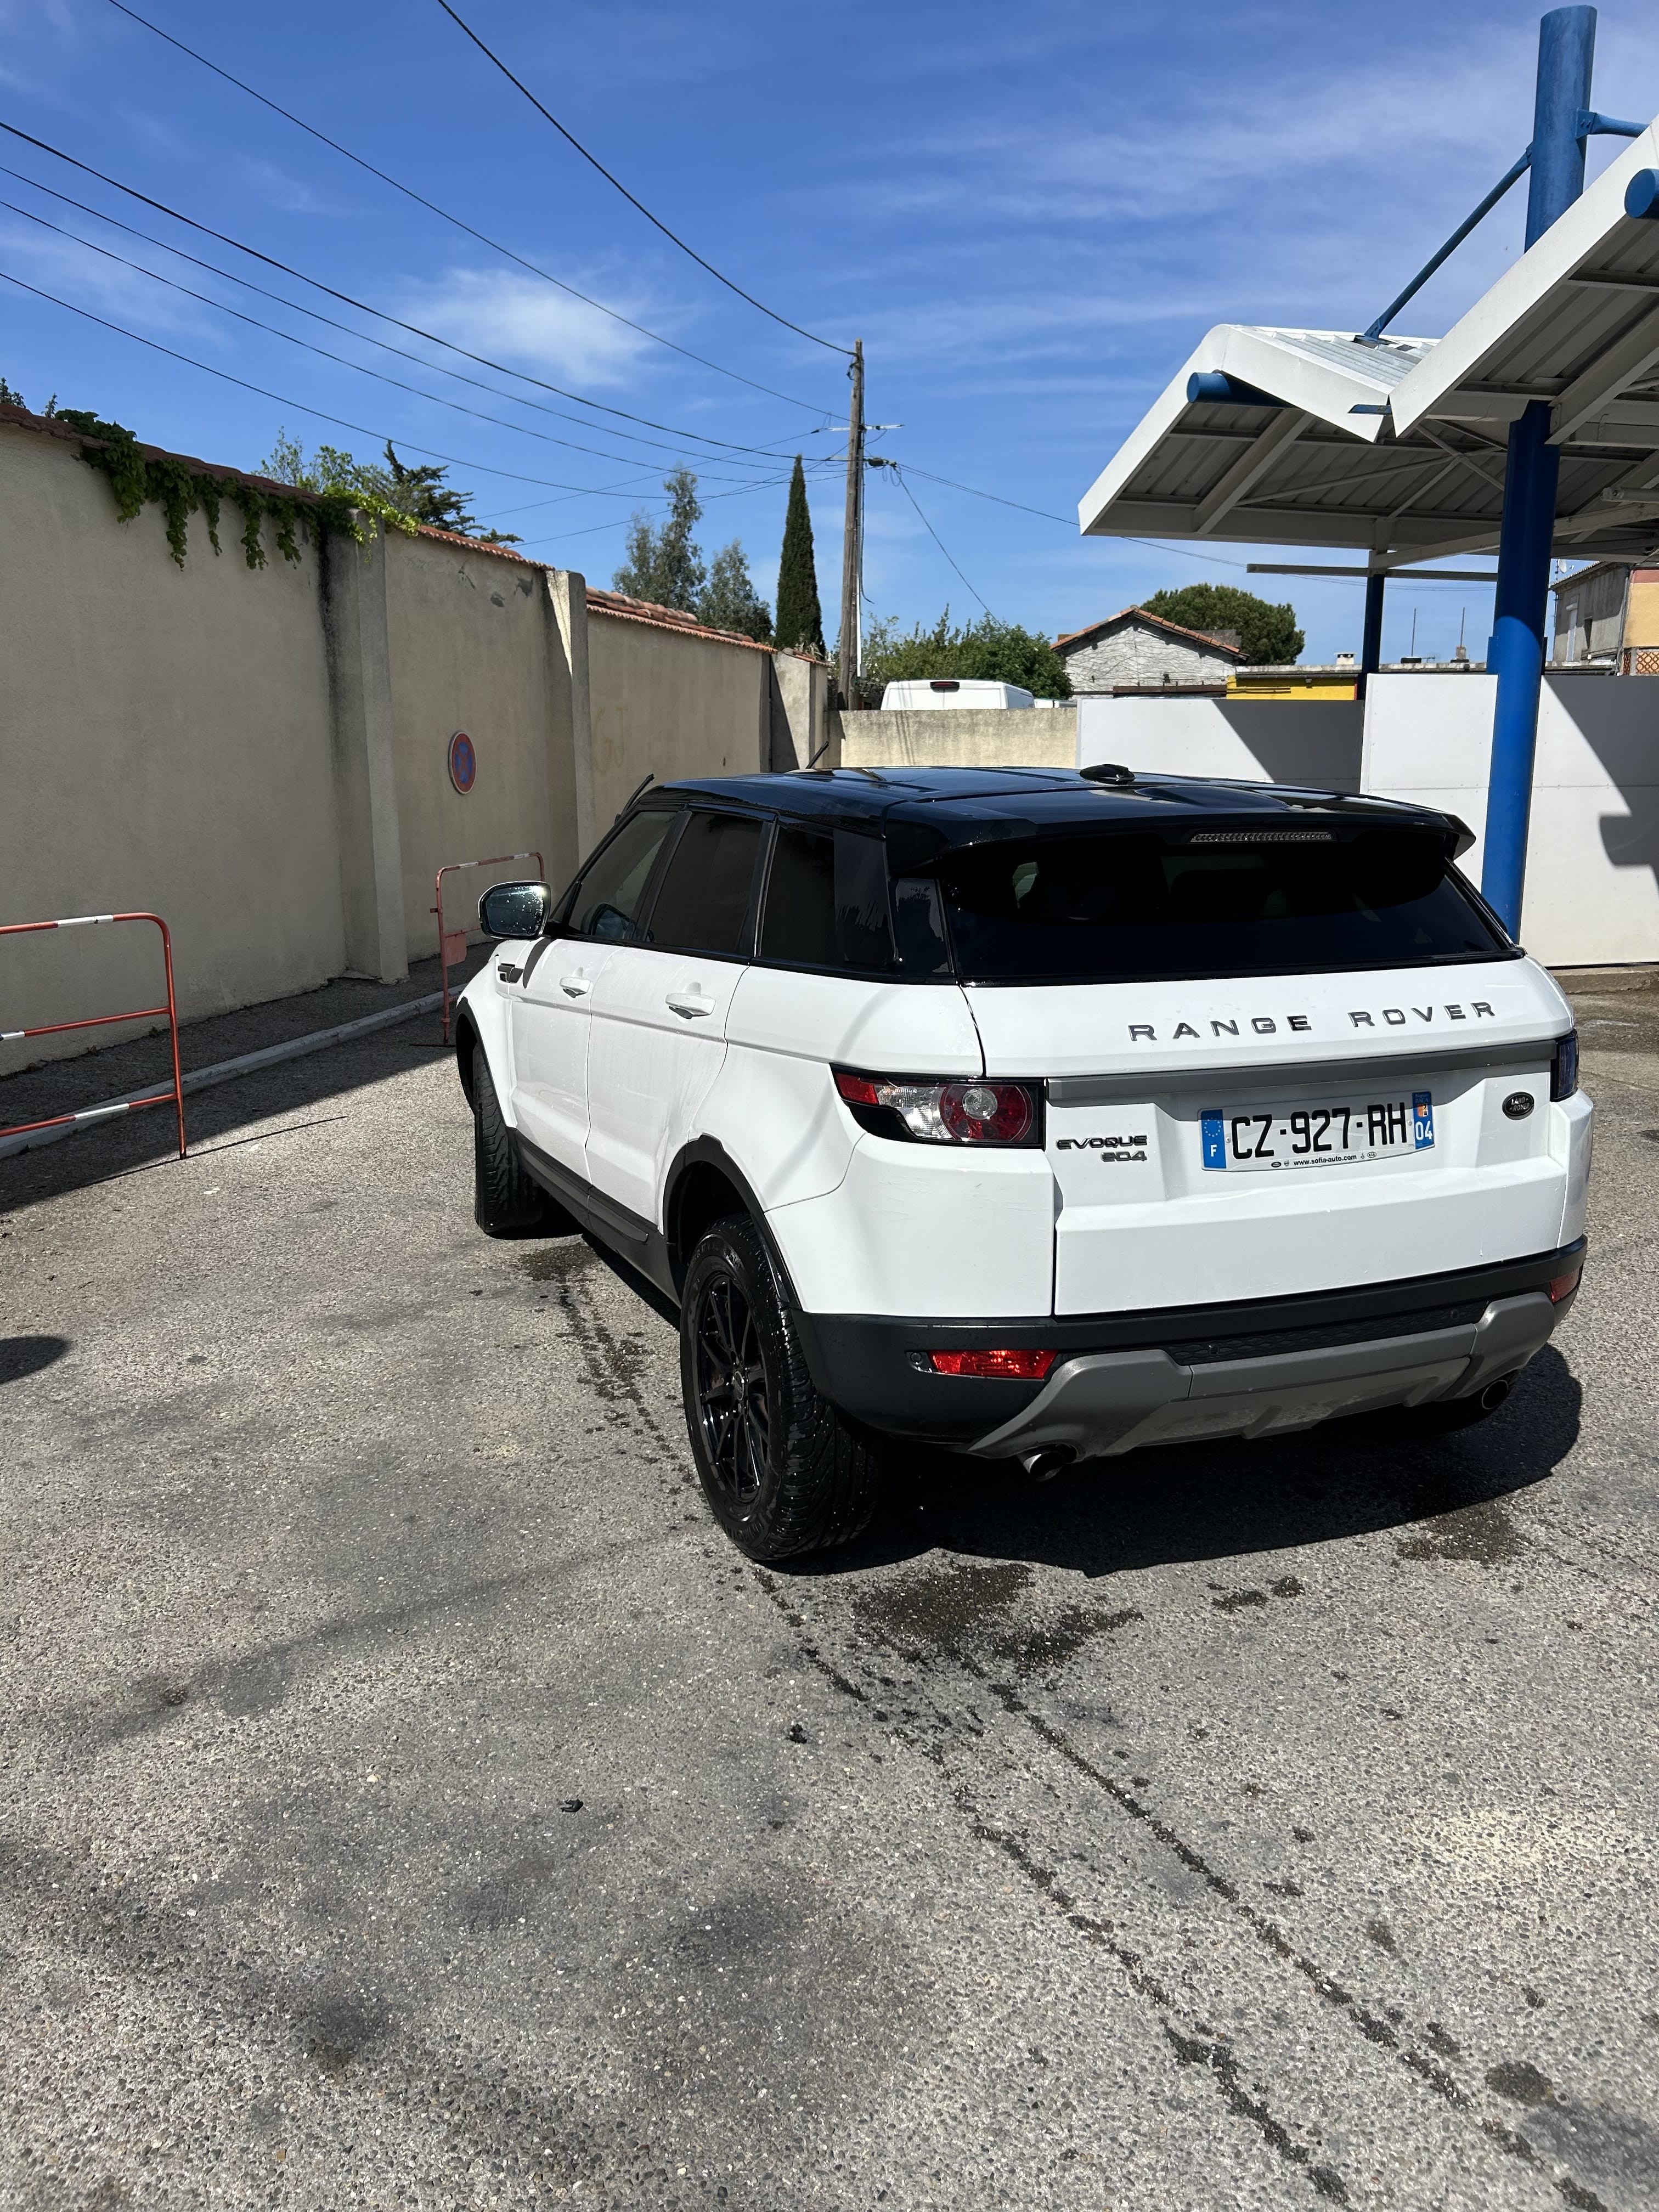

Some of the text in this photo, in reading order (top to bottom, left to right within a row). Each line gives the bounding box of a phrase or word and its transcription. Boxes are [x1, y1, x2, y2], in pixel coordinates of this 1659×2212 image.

[1127, 1002, 1496, 1041] RANGE ROVER
[1231, 1102, 1407, 1160] CZ-927-RH
[1415, 1120, 1433, 1140] 04
[1056, 1135, 1148, 1150] EVOQUE
[1210, 1144, 1217, 1158] F
[1293, 1154, 1357, 1166] www.sofia-auto.com
